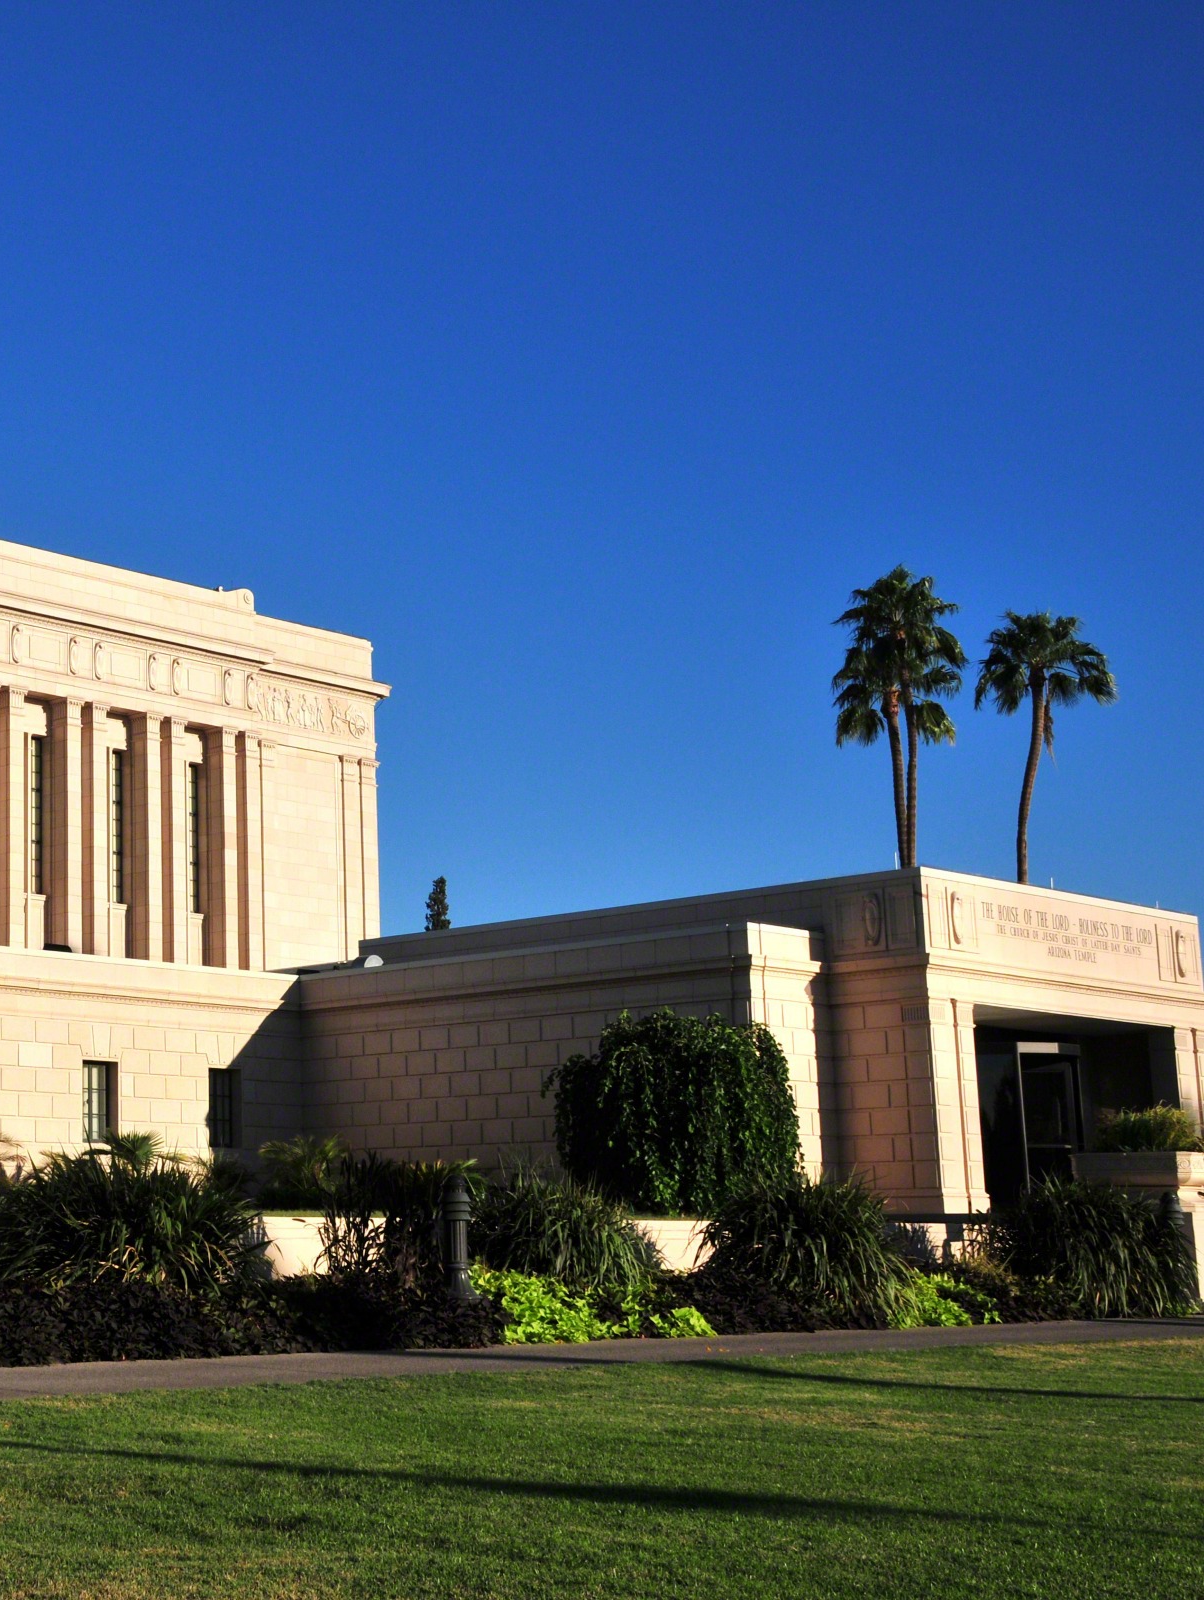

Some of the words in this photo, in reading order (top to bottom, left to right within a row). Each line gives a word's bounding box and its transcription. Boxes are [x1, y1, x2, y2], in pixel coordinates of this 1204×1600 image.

[981, 901, 994, 919] THE
[998, 904, 1019, 924] HOUSE
[1023, 908, 1032, 926] OF
[1035, 910, 1049, 928] THE
[1051, 913, 1070, 932] LORD
[1078, 918, 1109, 938] HOLINESS
[1110, 923, 1119, 940] TO
[1121, 924, 1133, 942] THE
[1135, 927, 1153, 945] LORD
[996, 924, 1007, 935] THE
[1009, 926, 1030, 939] CHURCH
[1032, 930, 1039, 940] OF
[1042, 931, 1058, 943] JESUS
[1061, 934, 1079, 947] CHRIST
[1081, 938, 1088, 948] OF
[1123, 944, 1142, 956] SAINTS
[1047, 946, 1072, 960] ARIZONA
[1073, 949, 1097, 964] TEMPLE
